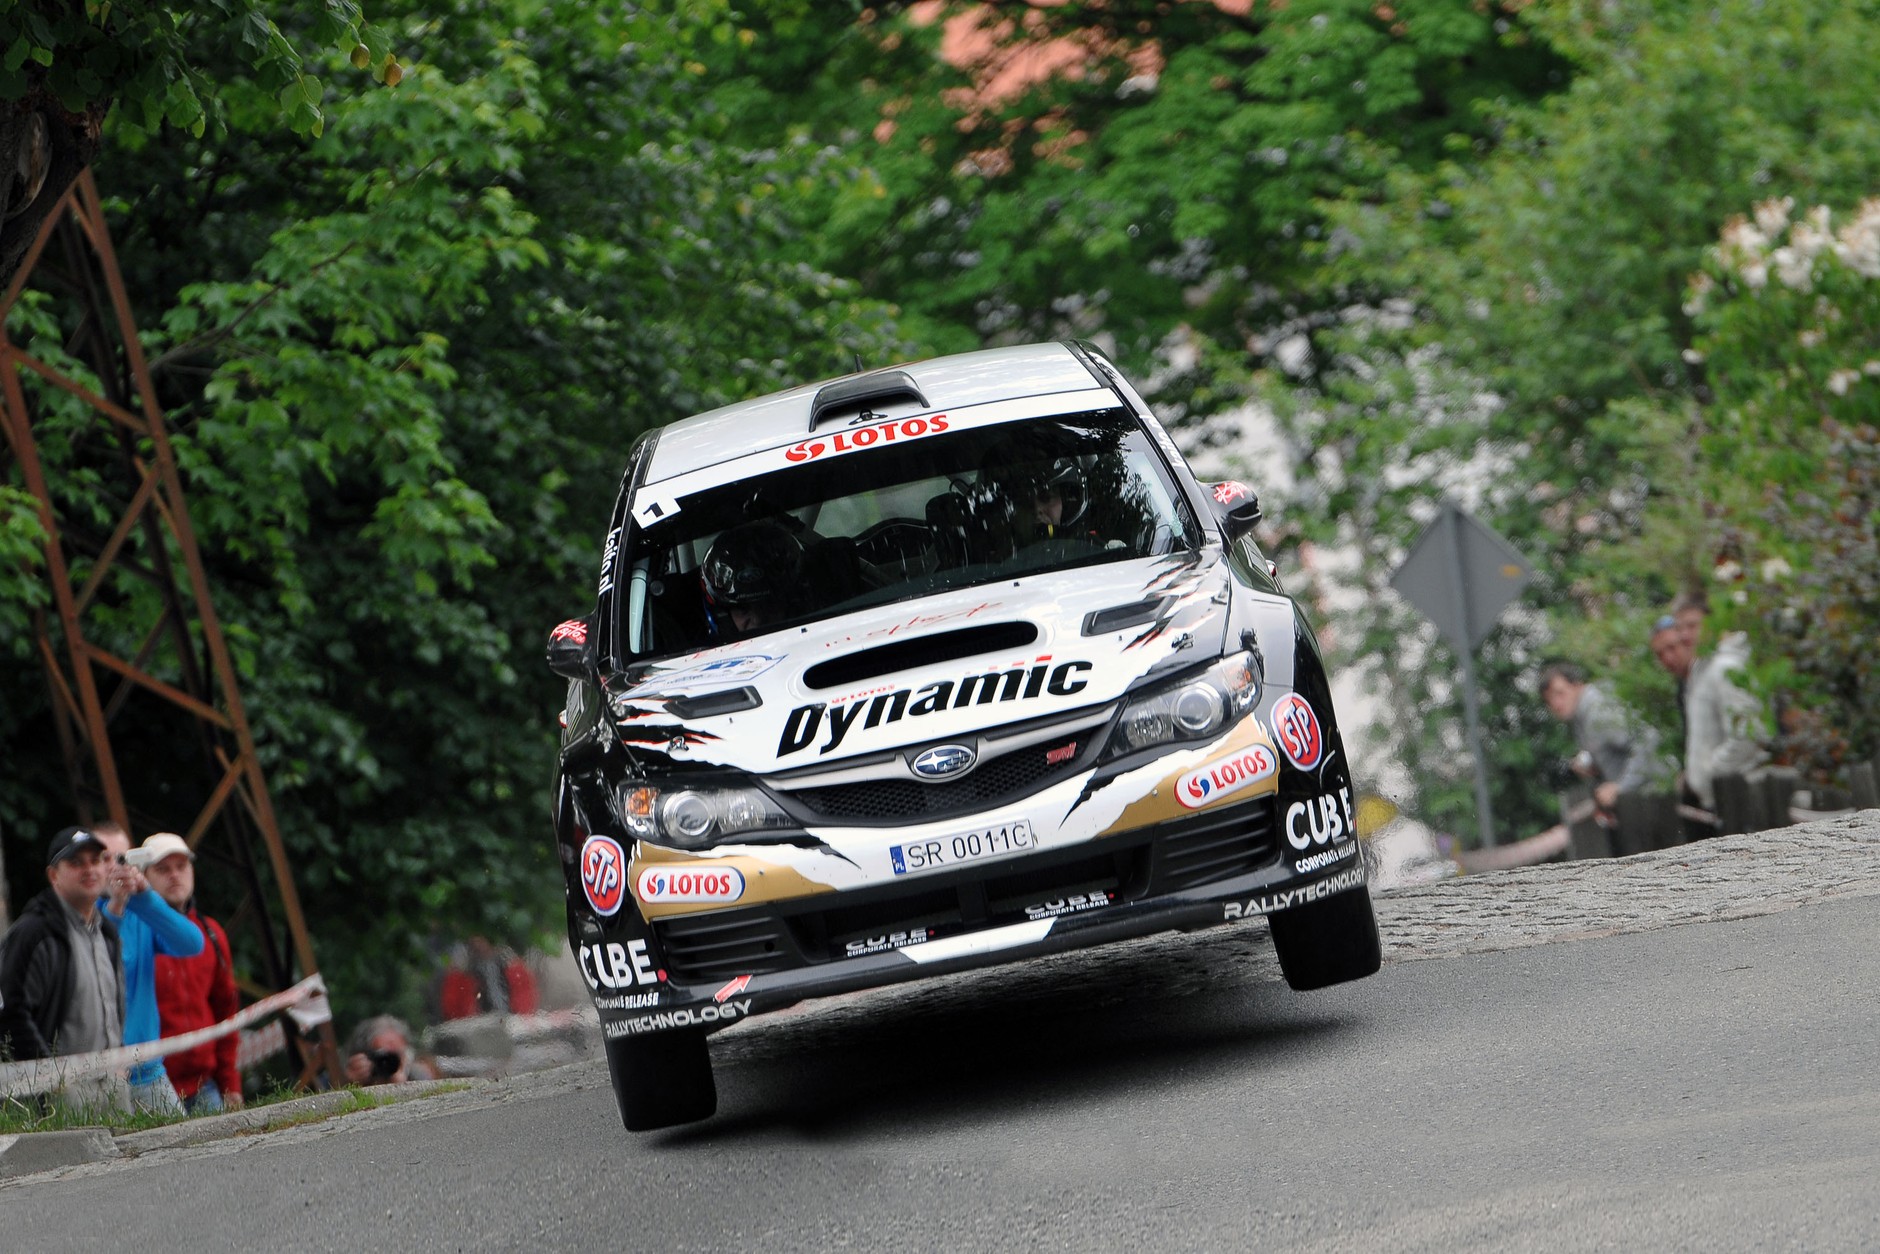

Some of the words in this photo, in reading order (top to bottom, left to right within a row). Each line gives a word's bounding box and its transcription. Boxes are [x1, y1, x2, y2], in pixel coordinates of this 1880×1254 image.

[833, 414, 949, 452] LOTOS
[642, 501, 665, 519] 1
[776, 654, 1093, 759] Dynamic
[1284, 701, 1312, 760] STP
[1210, 750, 1267, 790] LOTOS
[908, 841, 944, 868] SR
[952, 824, 1027, 859] 0011C
[1296, 849, 1339, 873] CORPORATE
[585, 846, 618, 897] STP
[669, 874, 731, 895] LOTOS
[895, 862, 905, 872] PL
[1224, 866, 1365, 920] RALLYTECHNOLOGY
[605, 998, 752, 1039] RALLYTECHNOLOGY
[625, 992, 659, 1009] RELEASE
